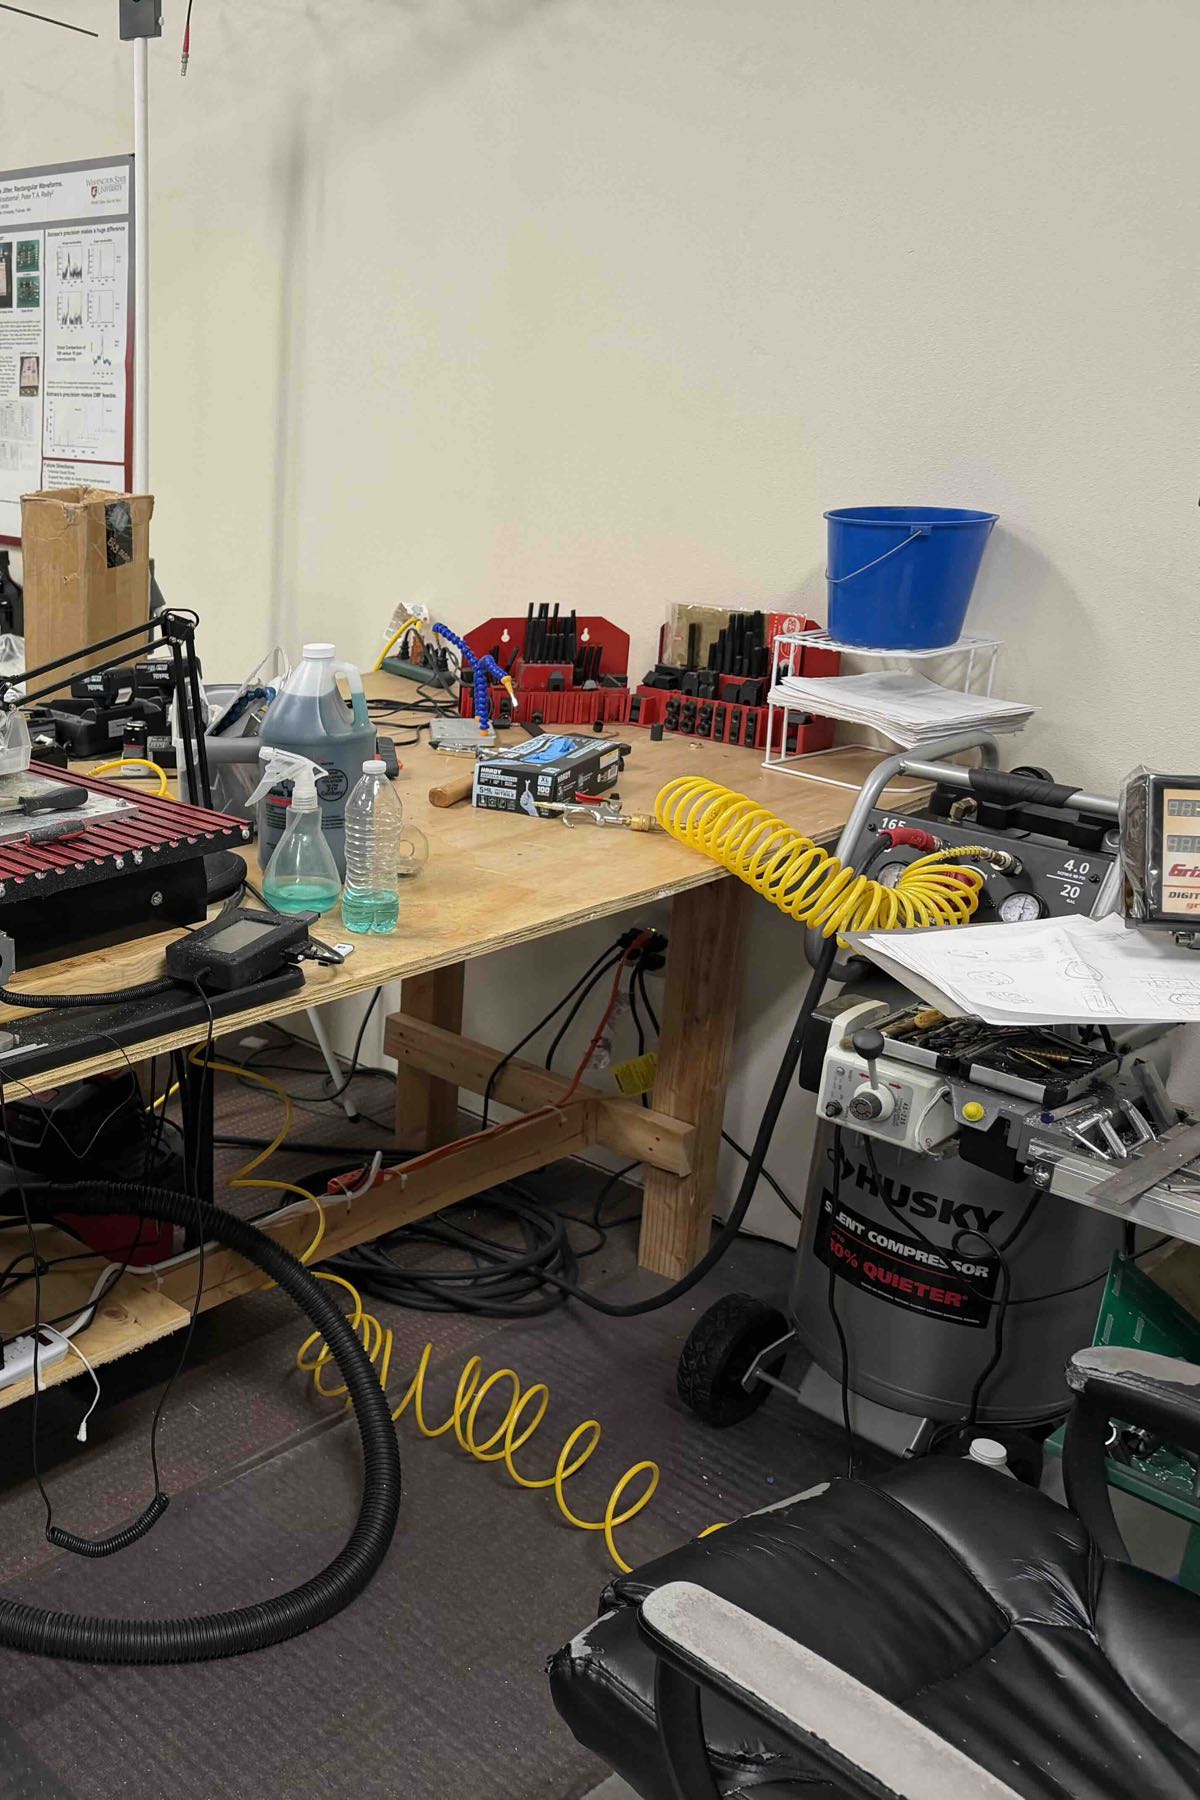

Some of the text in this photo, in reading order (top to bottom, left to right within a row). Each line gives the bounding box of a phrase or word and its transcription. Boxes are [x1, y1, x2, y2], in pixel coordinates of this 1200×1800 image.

[881, 817, 906, 829] 165
[1064, 860, 1090, 874] 4.0
[1060, 884, 1080, 898] 20
[855, 1163, 1004, 1233] HUSKY
[824, 1200, 865, 1235] SENT
